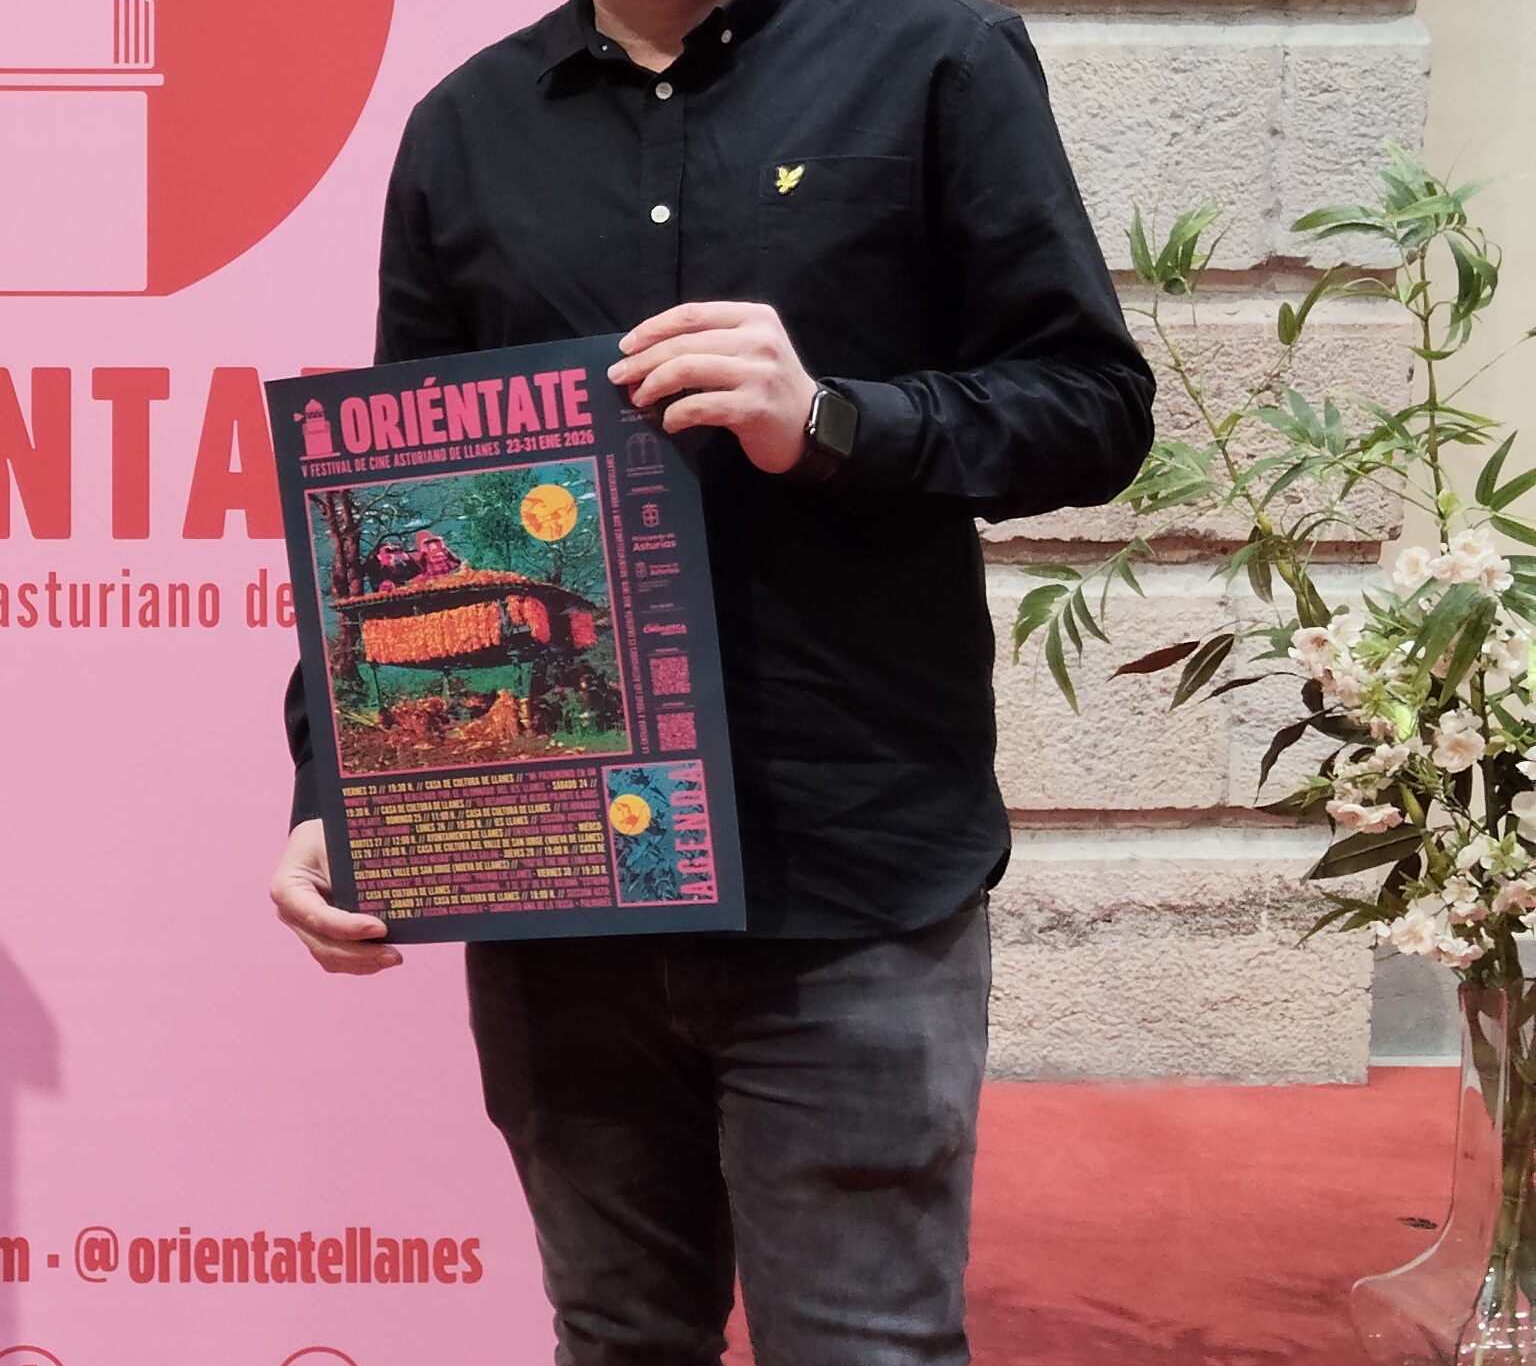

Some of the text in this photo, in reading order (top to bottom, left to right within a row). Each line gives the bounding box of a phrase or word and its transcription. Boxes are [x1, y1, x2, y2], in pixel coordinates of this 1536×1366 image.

[340, 368, 592, 454] ORIÉNTATE
[310, 461, 352, 477] FESTIVAL
[355, 458, 366, 472] DE
[370, 455, 390, 470] CINE
[394, 448, 447, 468] ASTURIANO
[449, 446, 461, 460] DE
[464, 442, 500, 458] LLANES
[506, 437, 537, 454] 23-31
[539, 434, 562, 451] ENE
[563, 430, 595, 446] 2026
[246, 569, 296, 628] de
